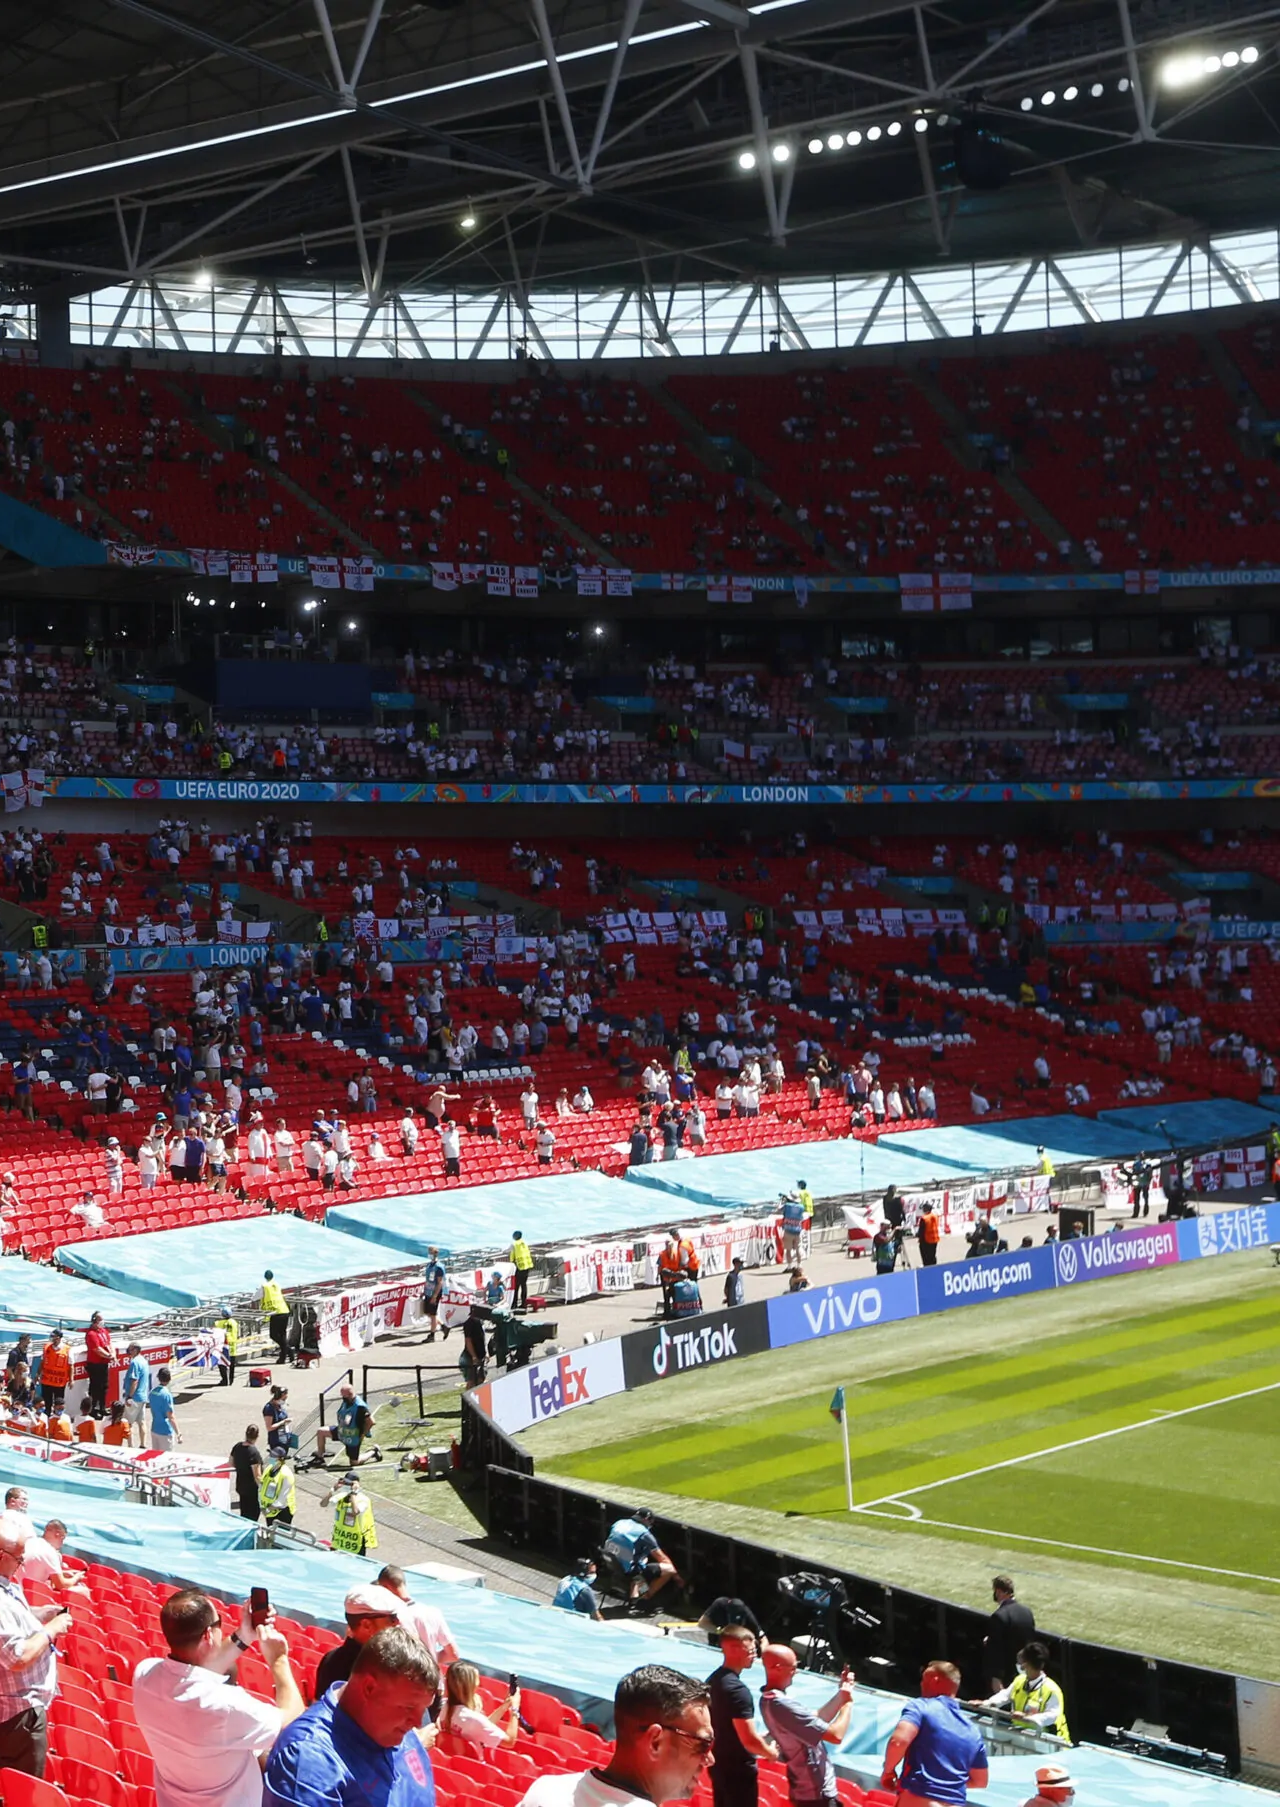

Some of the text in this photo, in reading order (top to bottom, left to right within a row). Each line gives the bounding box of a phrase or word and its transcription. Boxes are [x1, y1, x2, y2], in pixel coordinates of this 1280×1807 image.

[288, 559, 305, 574] UE
[751, 577, 785, 590] NDON
[175, 781, 299, 800] UEFA EURO 2020
[742, 786, 809, 802] LONDON
[1223, 922, 1268, 938] UEFA
[210, 946, 269, 966] LONDON
[1217, 1206, 1270, 1253] 支付宝
[1082, 1232, 1174, 1270] Volkswagen
[943, 1259, 1032, 1298] Booking.com
[372, 1290, 401, 1307] STIRLING
[803, 1286, 882, 1335] vivo
[672, 1322, 738, 1370] TikTok
[123, 1351, 168, 1366] RGERS
[528, 1355, 590, 1420] FedEx
